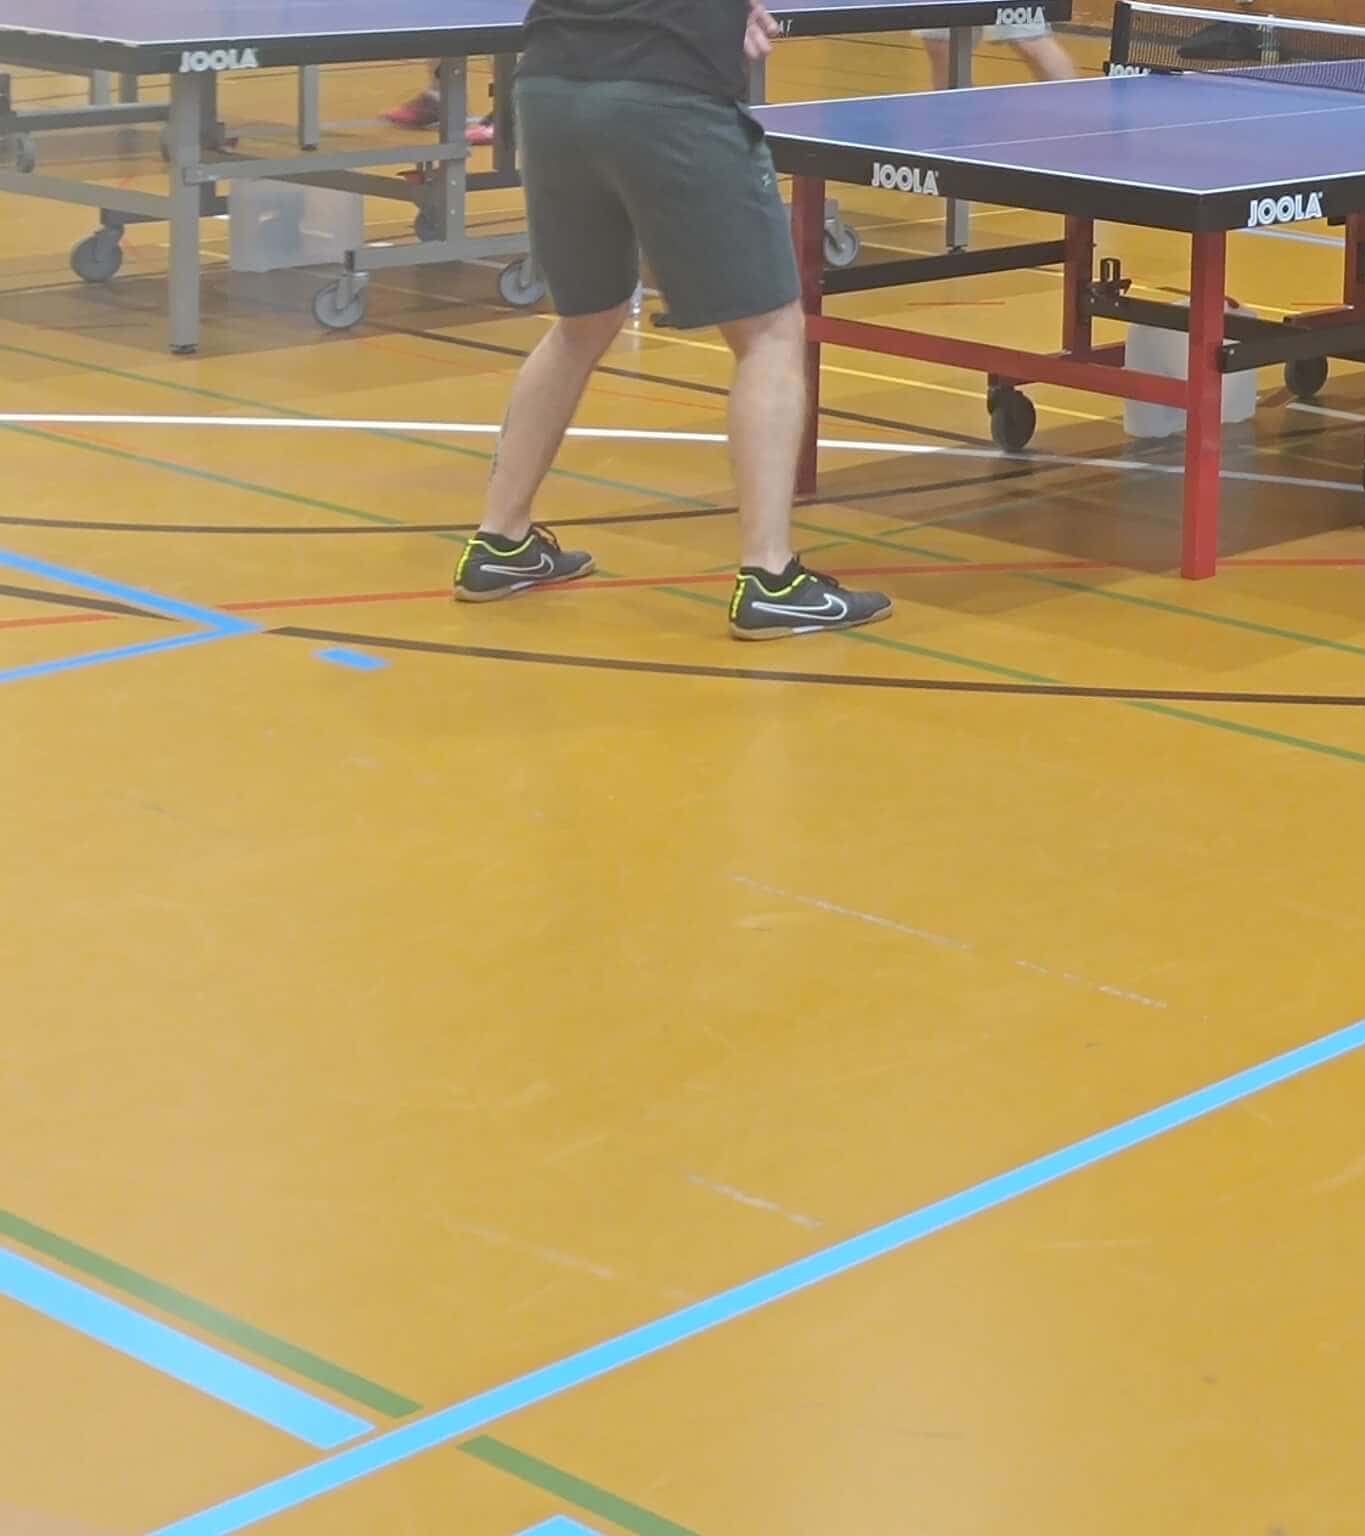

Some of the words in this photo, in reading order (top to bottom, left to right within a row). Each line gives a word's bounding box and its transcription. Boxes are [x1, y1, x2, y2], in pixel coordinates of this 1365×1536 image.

[995, 7, 1045, 25] JOOLA
[179, 48, 258, 72] JOOLA
[872, 162, 939, 196] JOOLA
[1248, 192, 1322, 227] JOOLA
